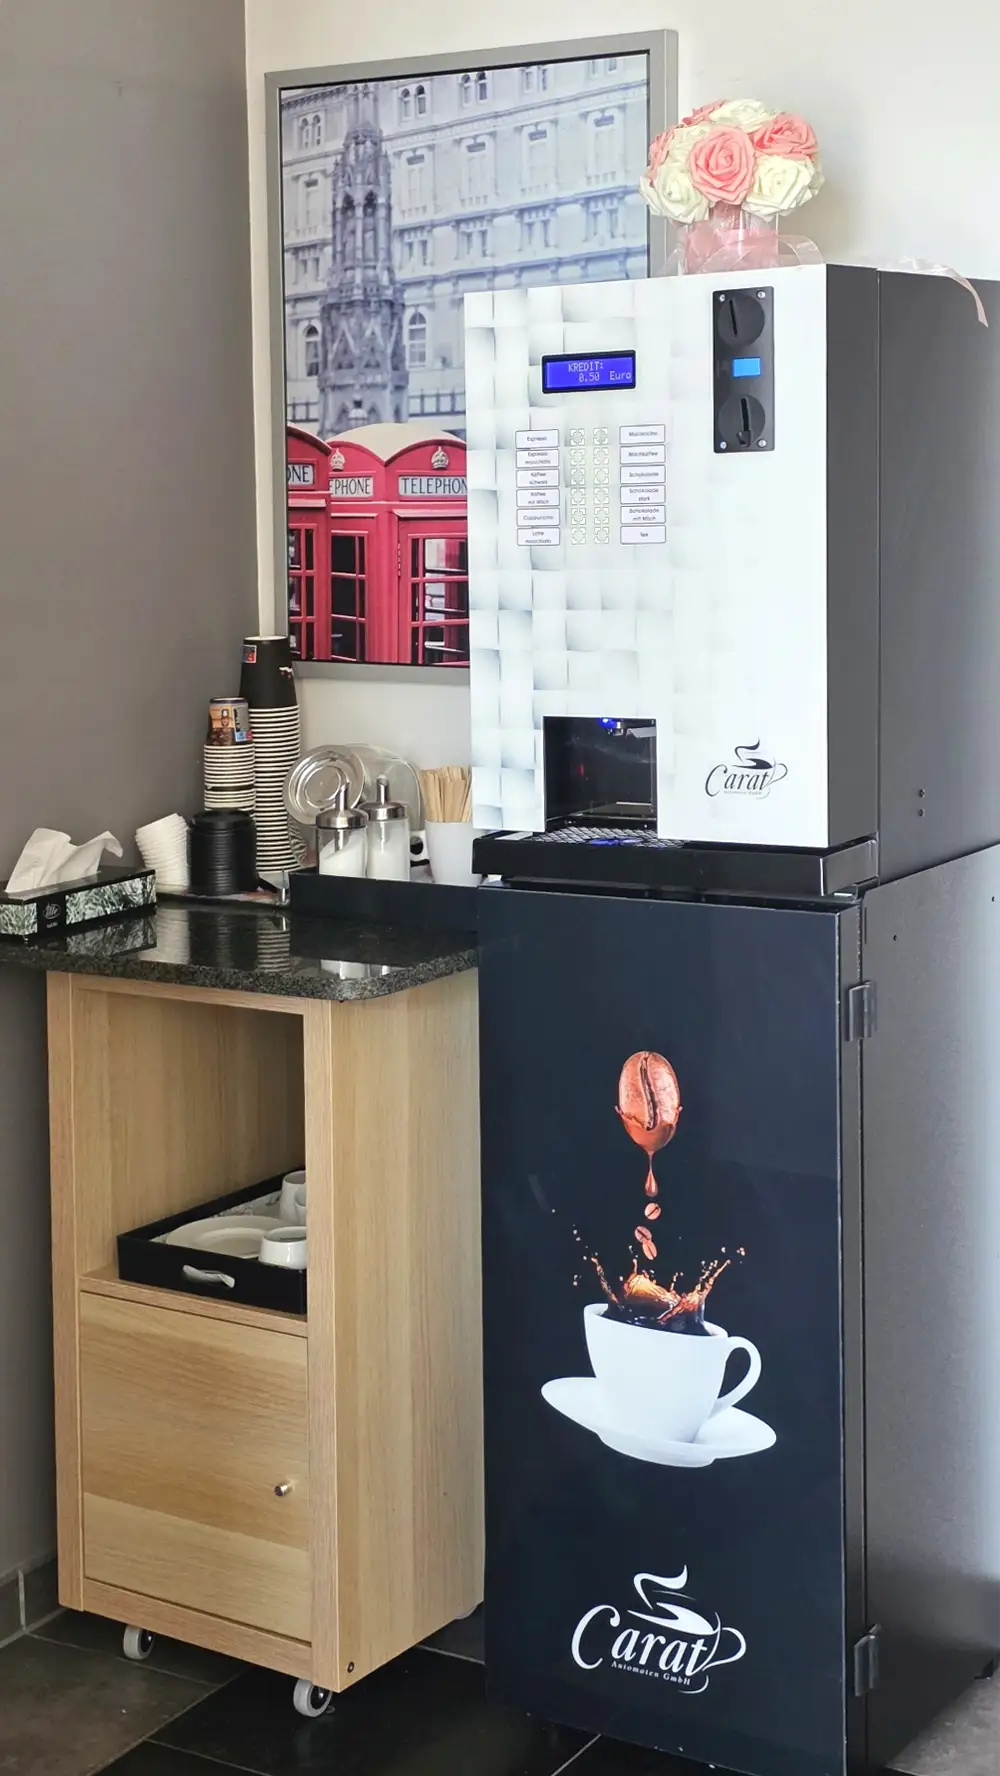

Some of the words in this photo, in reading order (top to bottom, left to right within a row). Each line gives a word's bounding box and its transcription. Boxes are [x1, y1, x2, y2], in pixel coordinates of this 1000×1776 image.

[568, 361, 604, 372] KREDIT:
[578, 372, 600, 382] 0.50
[609, 370, 632, 380] Euro
[401, 477, 467, 494] TELEPHON
[705, 763, 769, 797] Carat
[571, 1604, 708, 1677] Carat
[611, 1660, 659, 1678] Automaten
[663, 1672, 691, 1686] GmbH
